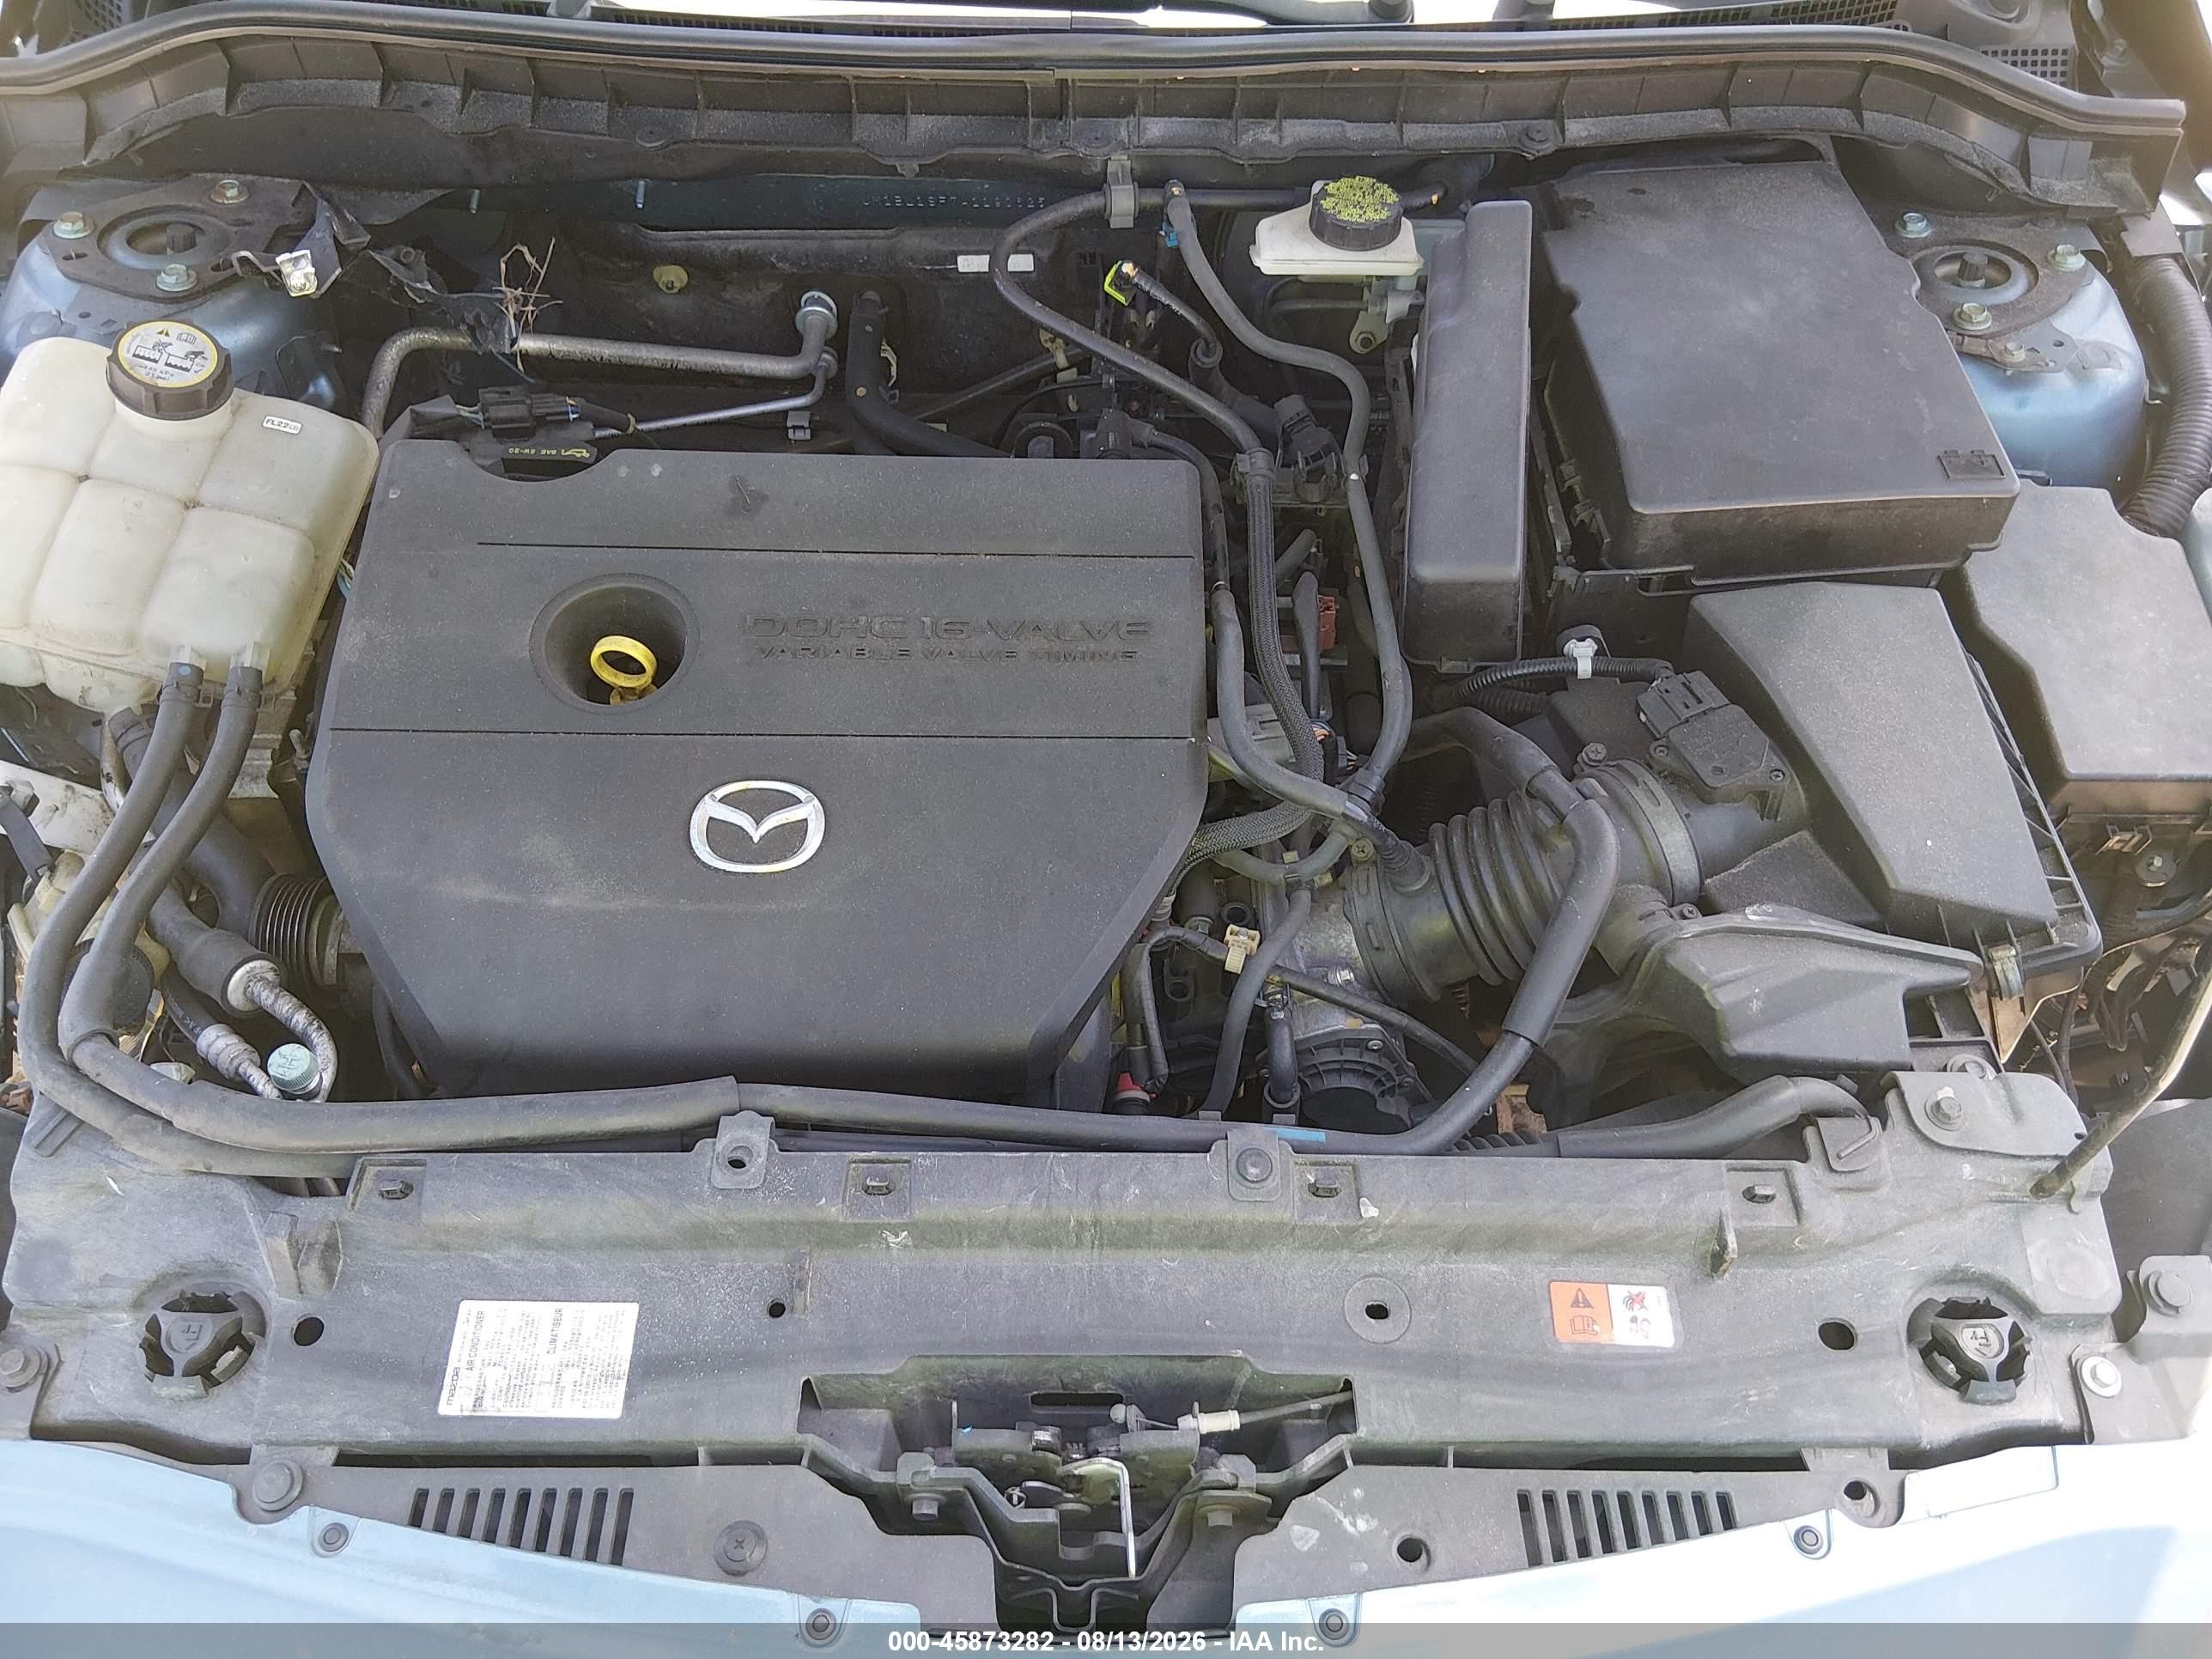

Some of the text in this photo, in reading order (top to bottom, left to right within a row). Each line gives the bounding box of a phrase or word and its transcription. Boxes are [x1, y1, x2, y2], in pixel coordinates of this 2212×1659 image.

[746, 616, 1149, 641] DOHC 16-VALVE
[756, 646, 1139, 663] VARIABLE VALVE TIMING
[468, 1310, 485, 1358] CONDITIONER
[547, 1308, 564, 1354] CLIMATISEUR
[465, 1359, 475, 1371] AIR
